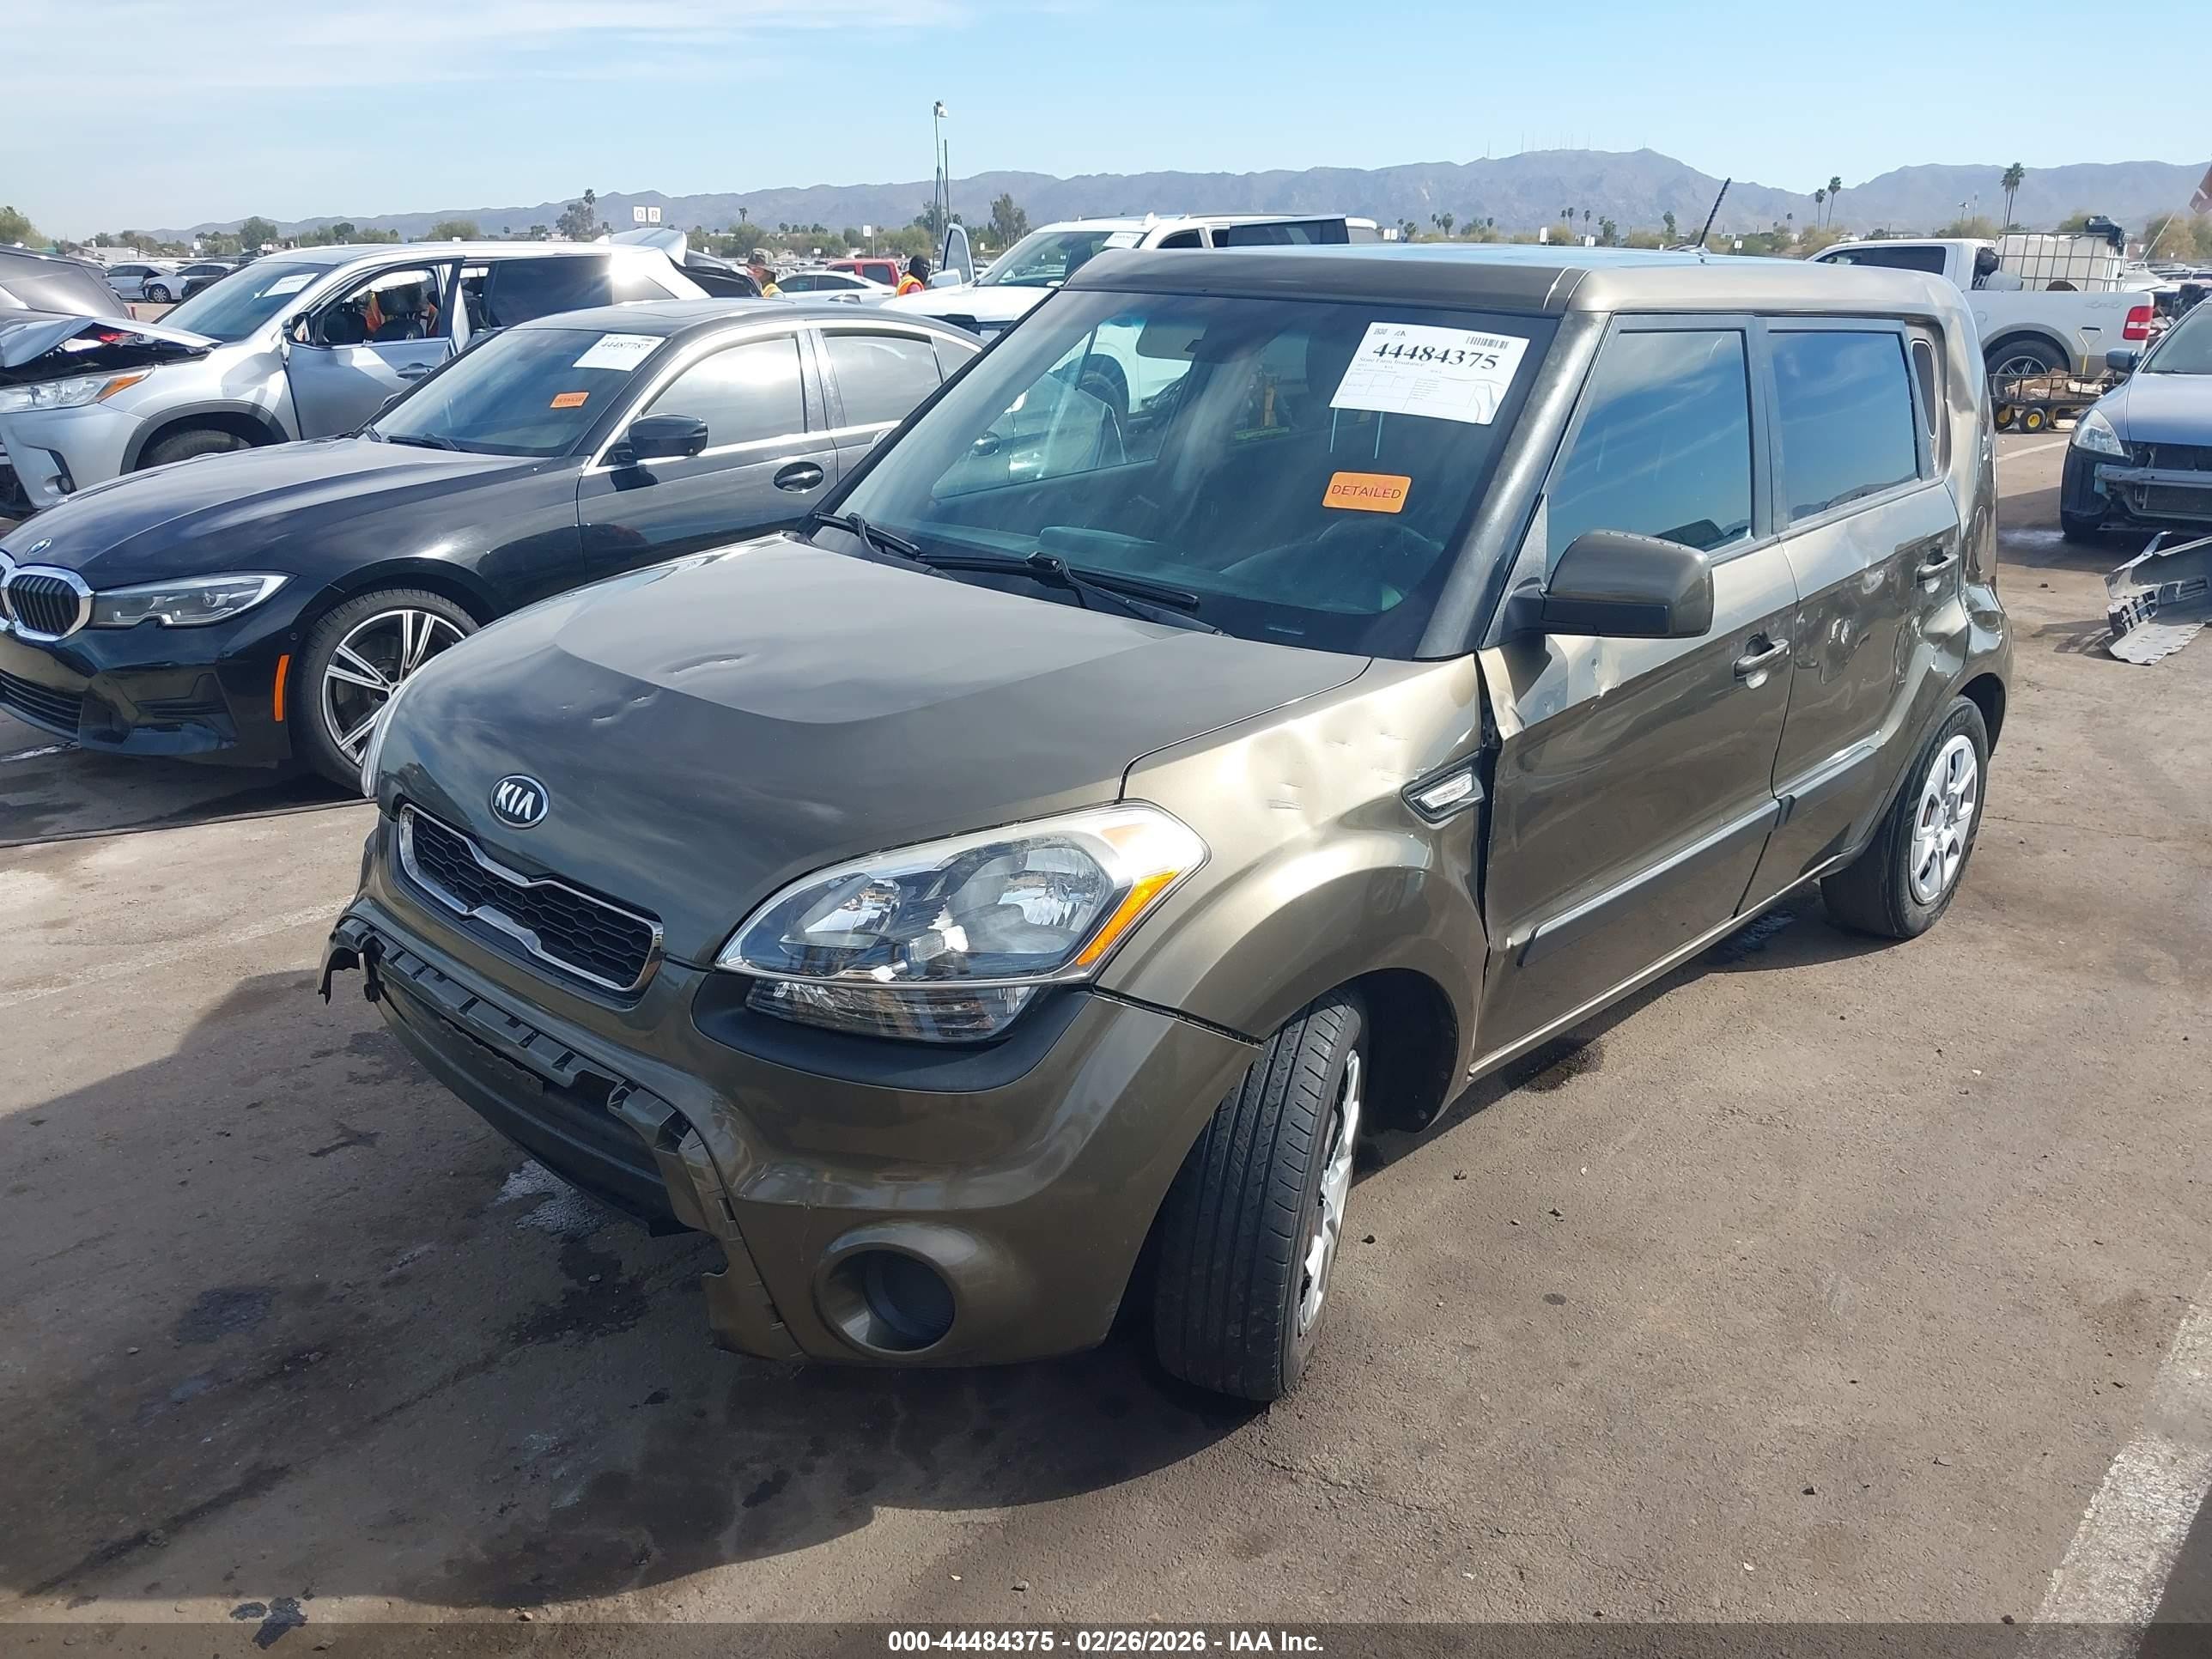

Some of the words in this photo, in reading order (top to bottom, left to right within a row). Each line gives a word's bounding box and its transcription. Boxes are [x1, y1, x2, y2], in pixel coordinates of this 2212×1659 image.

[1372, 342, 1500, 370] 44484375
[1331, 484, 1402, 499] DETAILED
[495, 781, 536, 820] KIA
